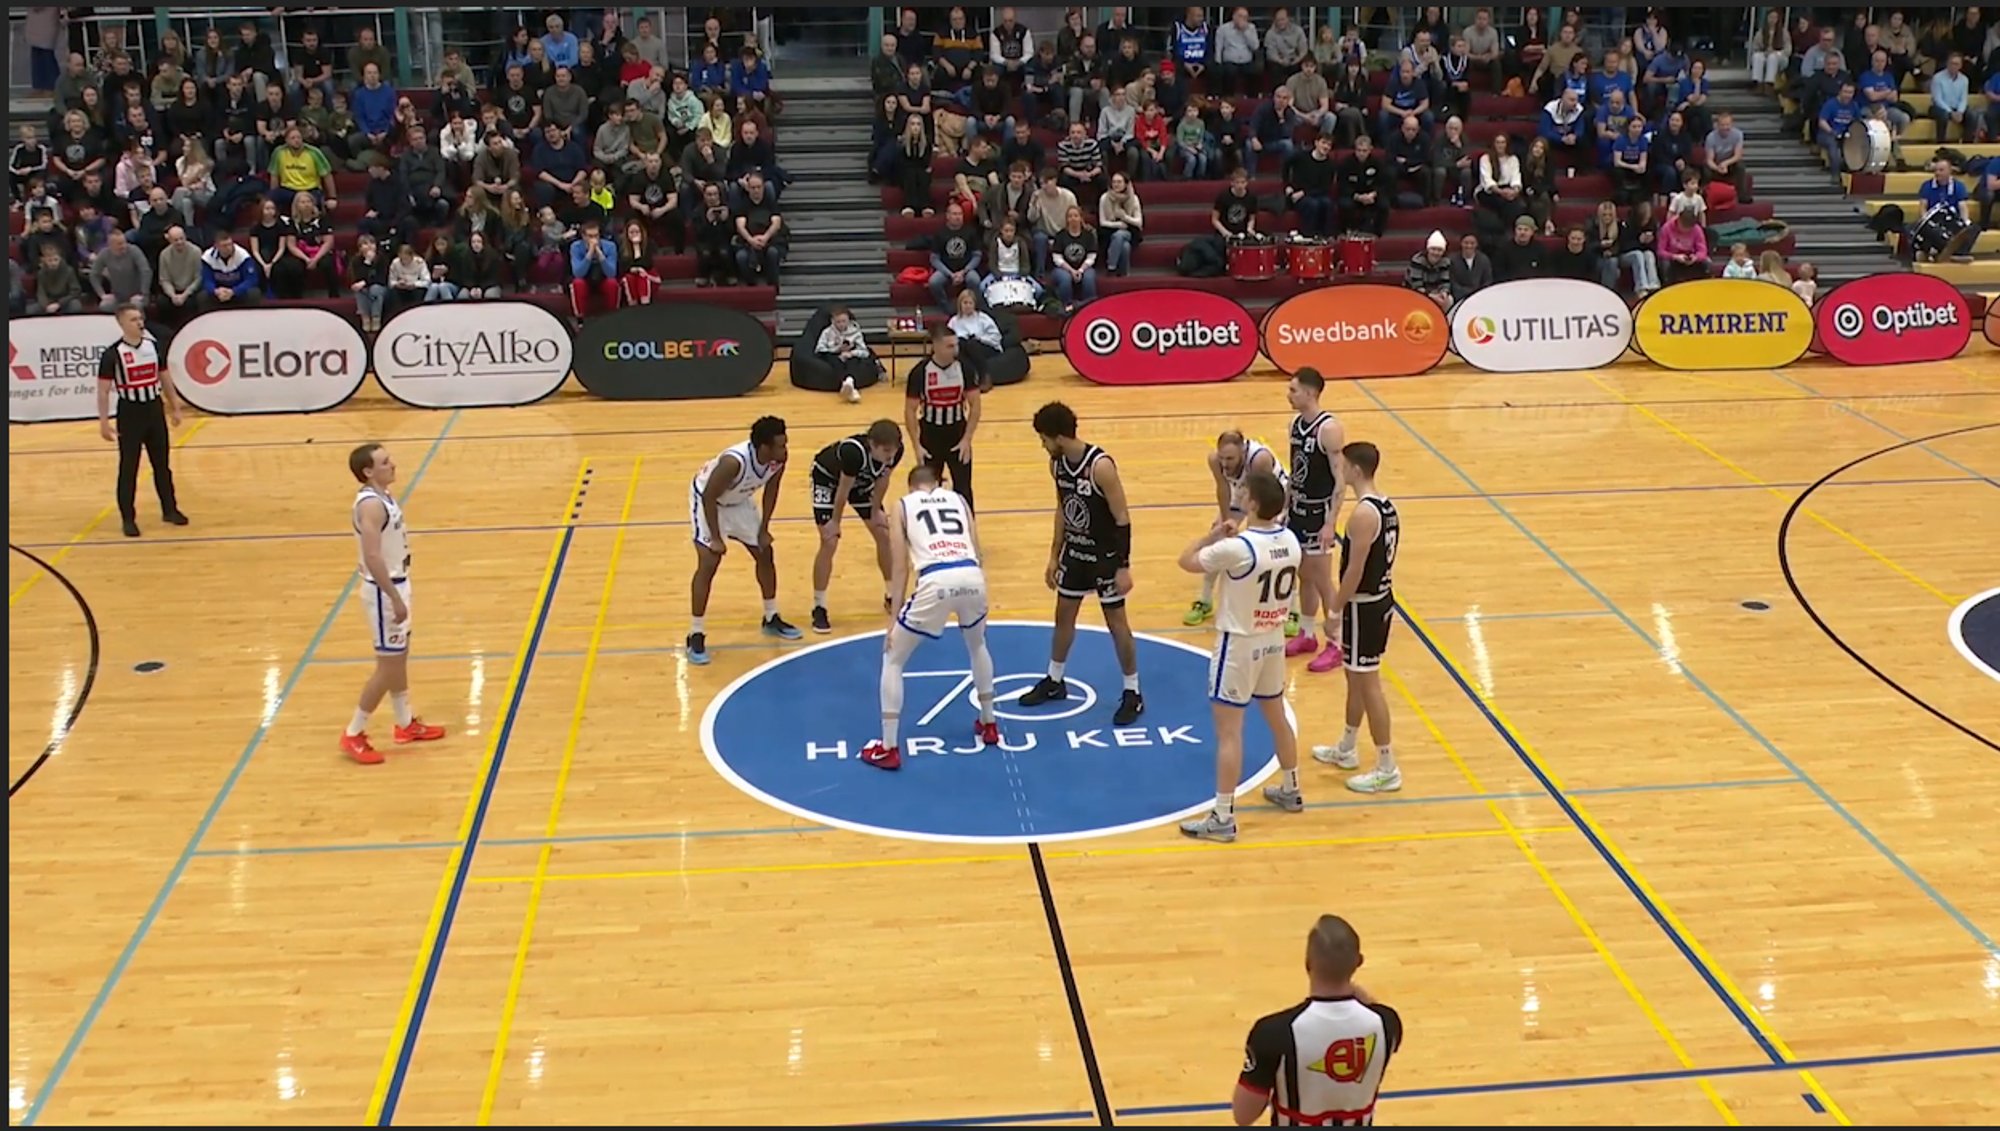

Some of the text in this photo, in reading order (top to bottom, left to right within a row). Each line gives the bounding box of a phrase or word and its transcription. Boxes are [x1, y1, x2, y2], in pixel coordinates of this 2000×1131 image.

[1278, 318, 1398, 345] Swedbank
[1502, 313, 1620, 342] UTILITAS
[1659, 311, 1788, 335] RAMIRENT
[1872, 301, 1958, 337] Optibet
[603, 339, 706, 361] COOLBET
[1131, 320, 1240, 354] Optibet
[238, 341, 348, 379] Elora
[391, 328, 559, 376] CityAlko
[48, 386, 71, 397] for
[74, 384, 96, 395] the
[1076, 478, 1092, 496] 23
[915, 508, 964, 535] 15
[1257, 565, 1296, 603] 10
[1066, 724, 1203, 749] KEK
